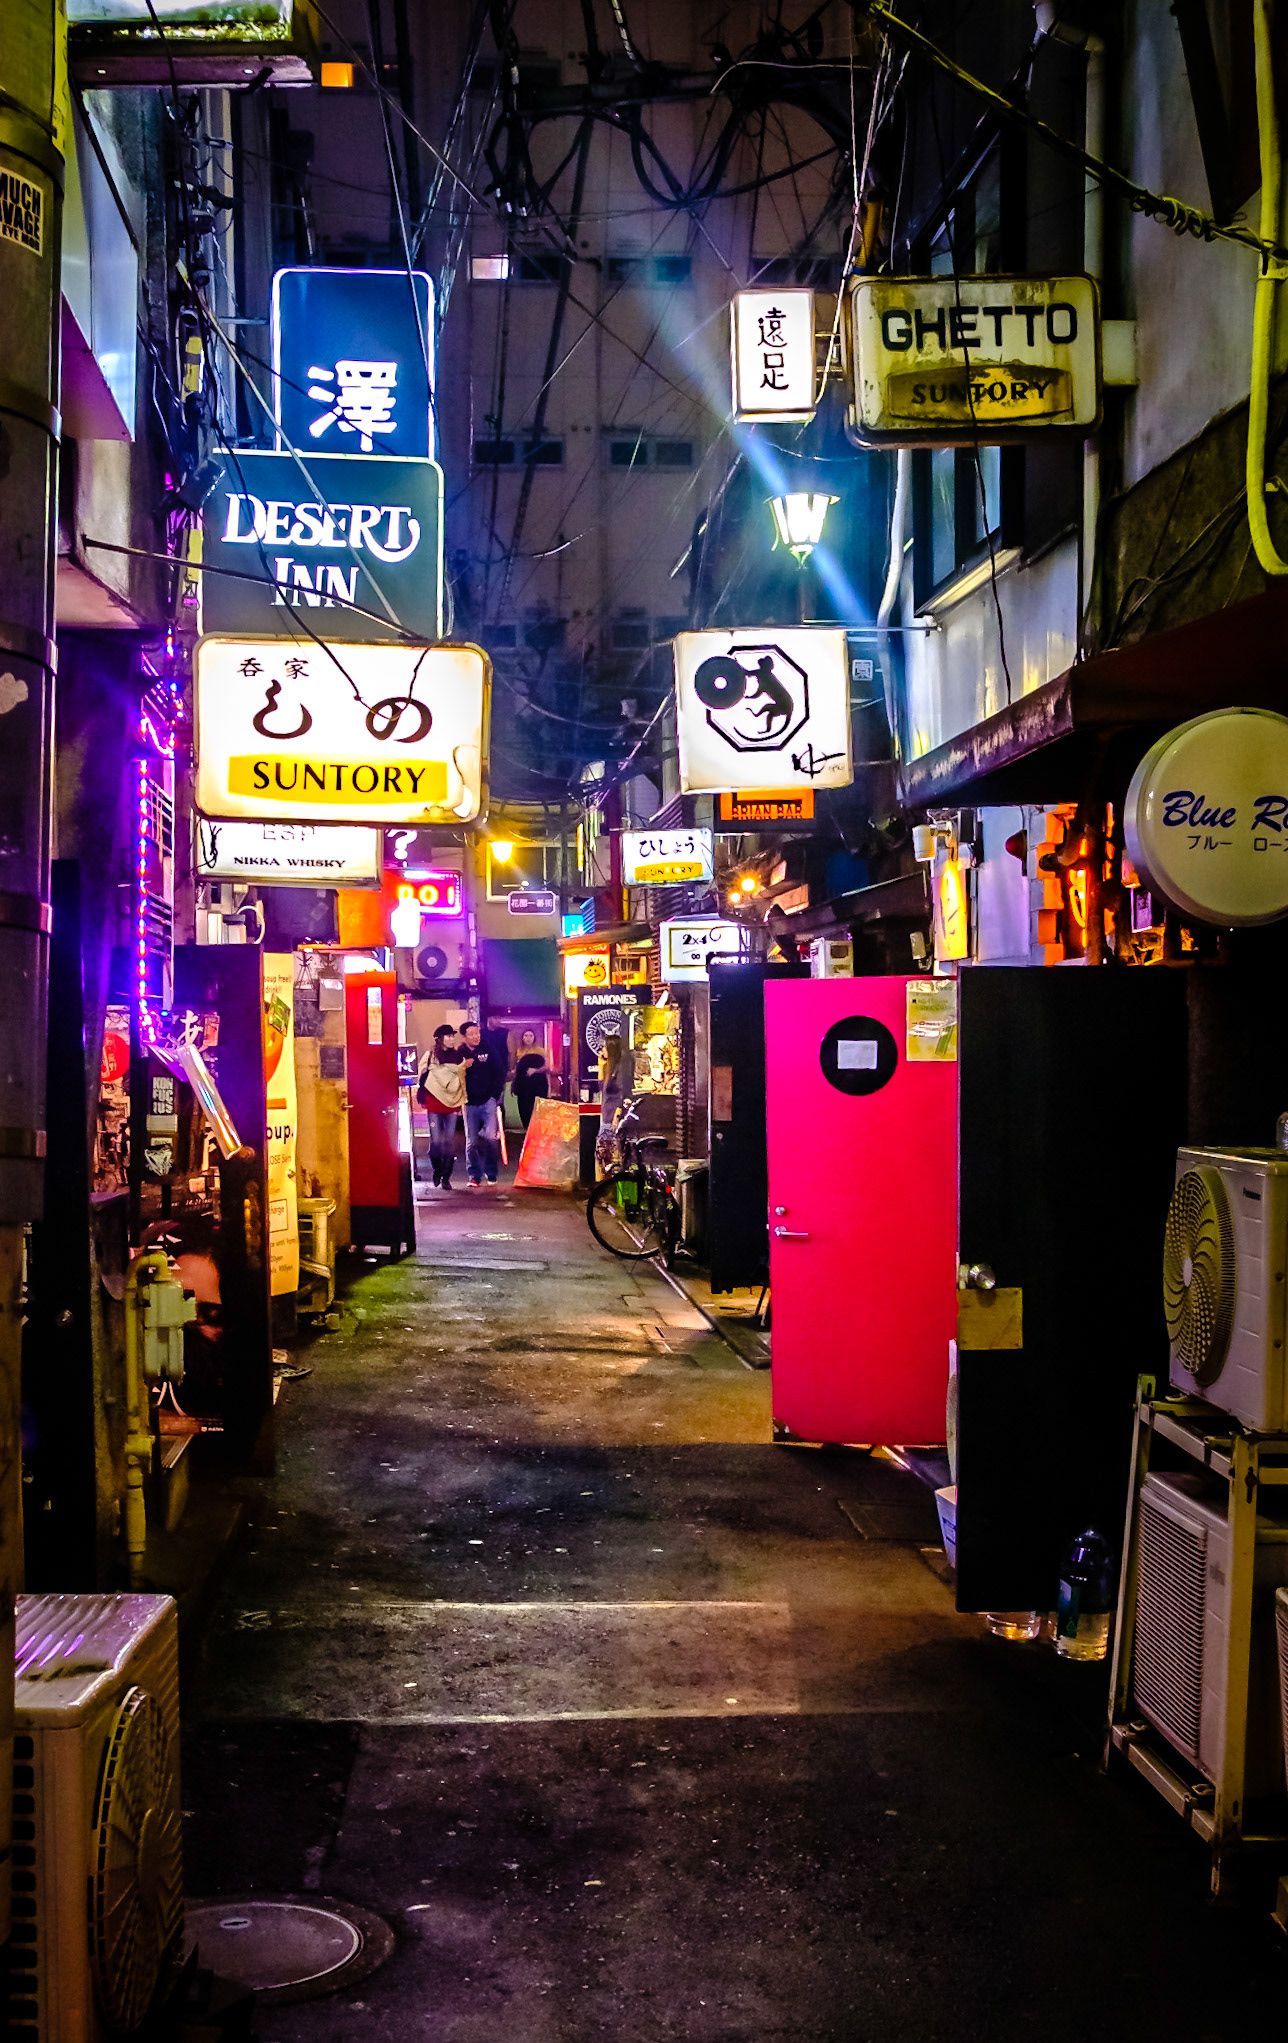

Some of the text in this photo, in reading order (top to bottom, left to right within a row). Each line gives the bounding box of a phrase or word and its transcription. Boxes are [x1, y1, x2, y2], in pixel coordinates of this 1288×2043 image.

[0, 199, 40, 240] VAGE
[881, 303, 1078, 351] GHETTO
[757, 307, 790, 390] 遠足
[306, 360, 398, 452] 澤
[911, 379, 1051, 404] SUNTORY
[221, 492, 421, 563] DESERT
[271, 557, 360, 608] INN
[253, 679, 433, 744] しの
[253, 761, 426, 794] SUNTORY
[1162, 790, 1237, 829] Blue
[233, 856, 346, 868] NIKKA WHISKY
[639, 836, 695, 858] ひしょう
[643, 865, 694, 877] UNORY
[583, 994, 637, 1005] RAMONES
